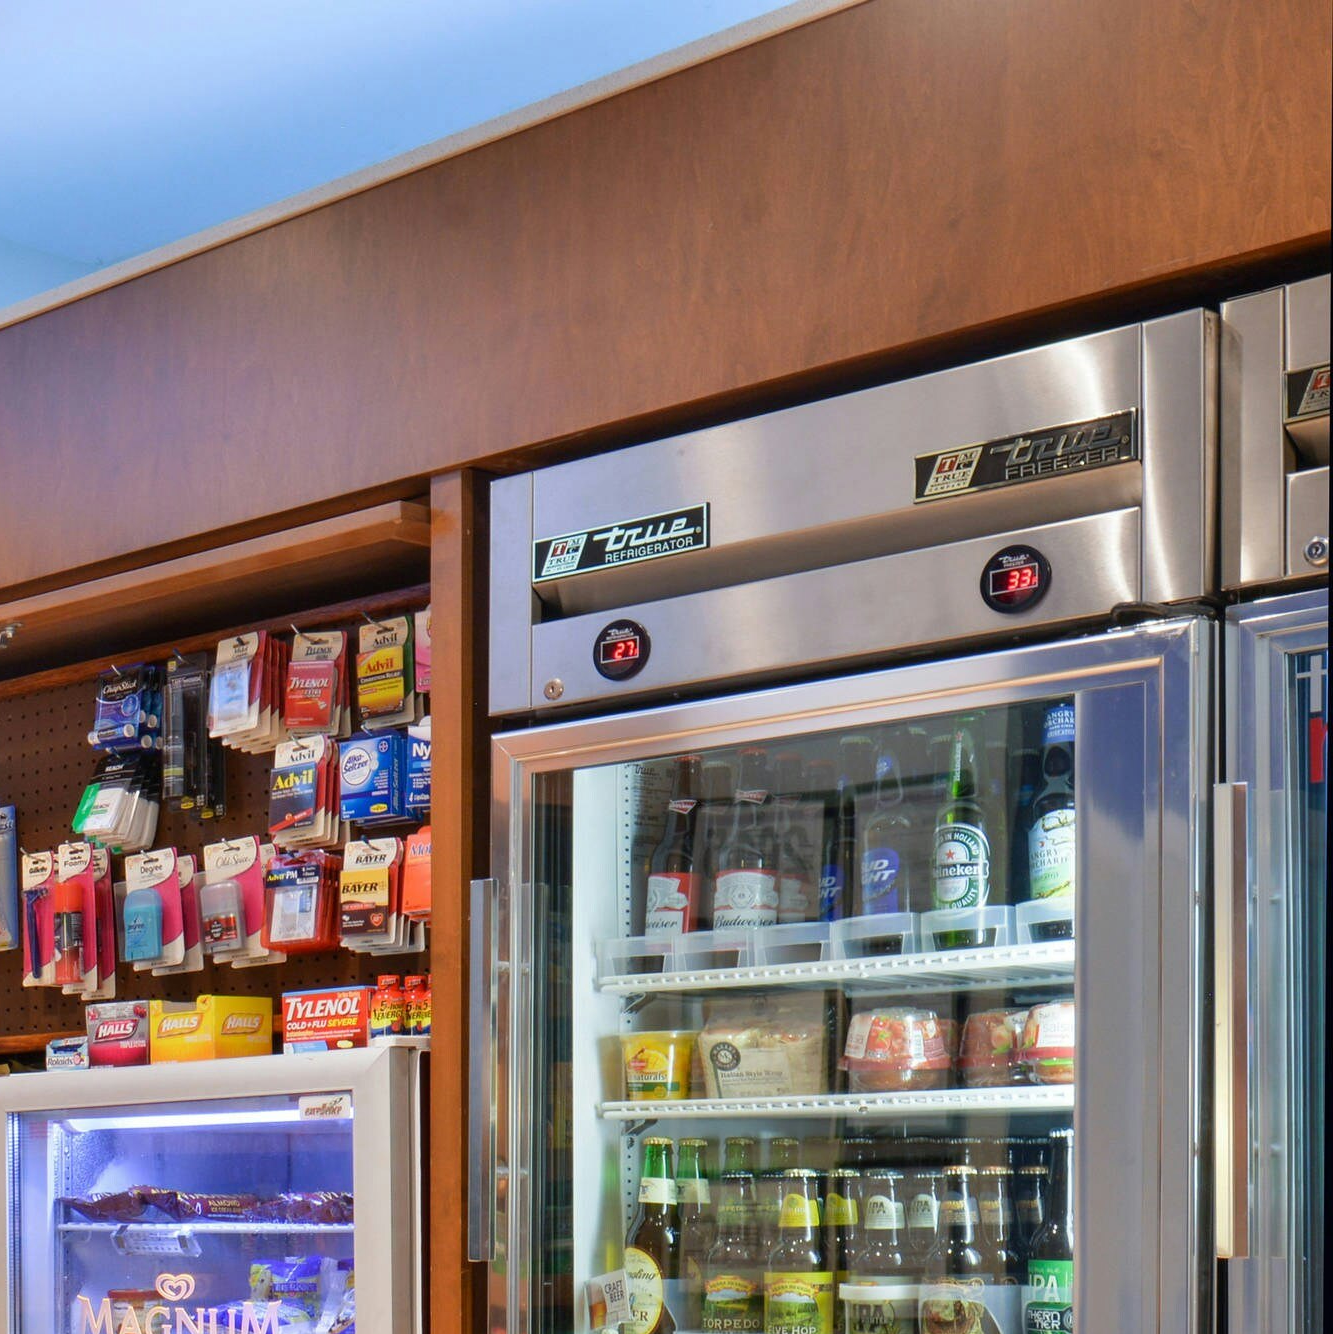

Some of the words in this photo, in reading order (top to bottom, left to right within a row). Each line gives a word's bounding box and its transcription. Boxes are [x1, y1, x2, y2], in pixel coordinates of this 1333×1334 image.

[990, 425, 1121, 465] true
[1005, 447, 1120, 480] FREEZER
[593, 518, 694, 551] true
[605, 537, 693, 563] REFRIGERATOR
[373, 634, 397, 645] Advil
[365, 658, 394, 673] Advil
[289, 677, 329, 688] TYLENOL
[288, 751, 315, 762] Advil
[273, 770, 313, 789] Advil
[64, 860, 87, 868] Foamy
[356, 854, 387, 864] BAYER
[140, 864, 163, 874] Degree
[342, 882, 378, 894] BAYER
[715, 914, 774, 928] Budweiser
[285, 998, 360, 1021] TYLENOL
[161, 1016, 198, 1030] HALLS
[226, 1015, 260, 1029] HALLS
[327, 1018, 358, 1027] SEVERE
[98, 1023, 133, 1037] HALLS
[48, 1057, 73, 1066] Rolaids
[604, 1279, 623, 1294] CRAFT
[1029, 1275, 1060, 1302] IPA
[610, 1291, 624, 1303] BEER
[703, 1318, 760, 1329] TORPEDO
[792, 1326, 816, 1334] HOP
[1036, 1320, 1060, 1330] TIER
